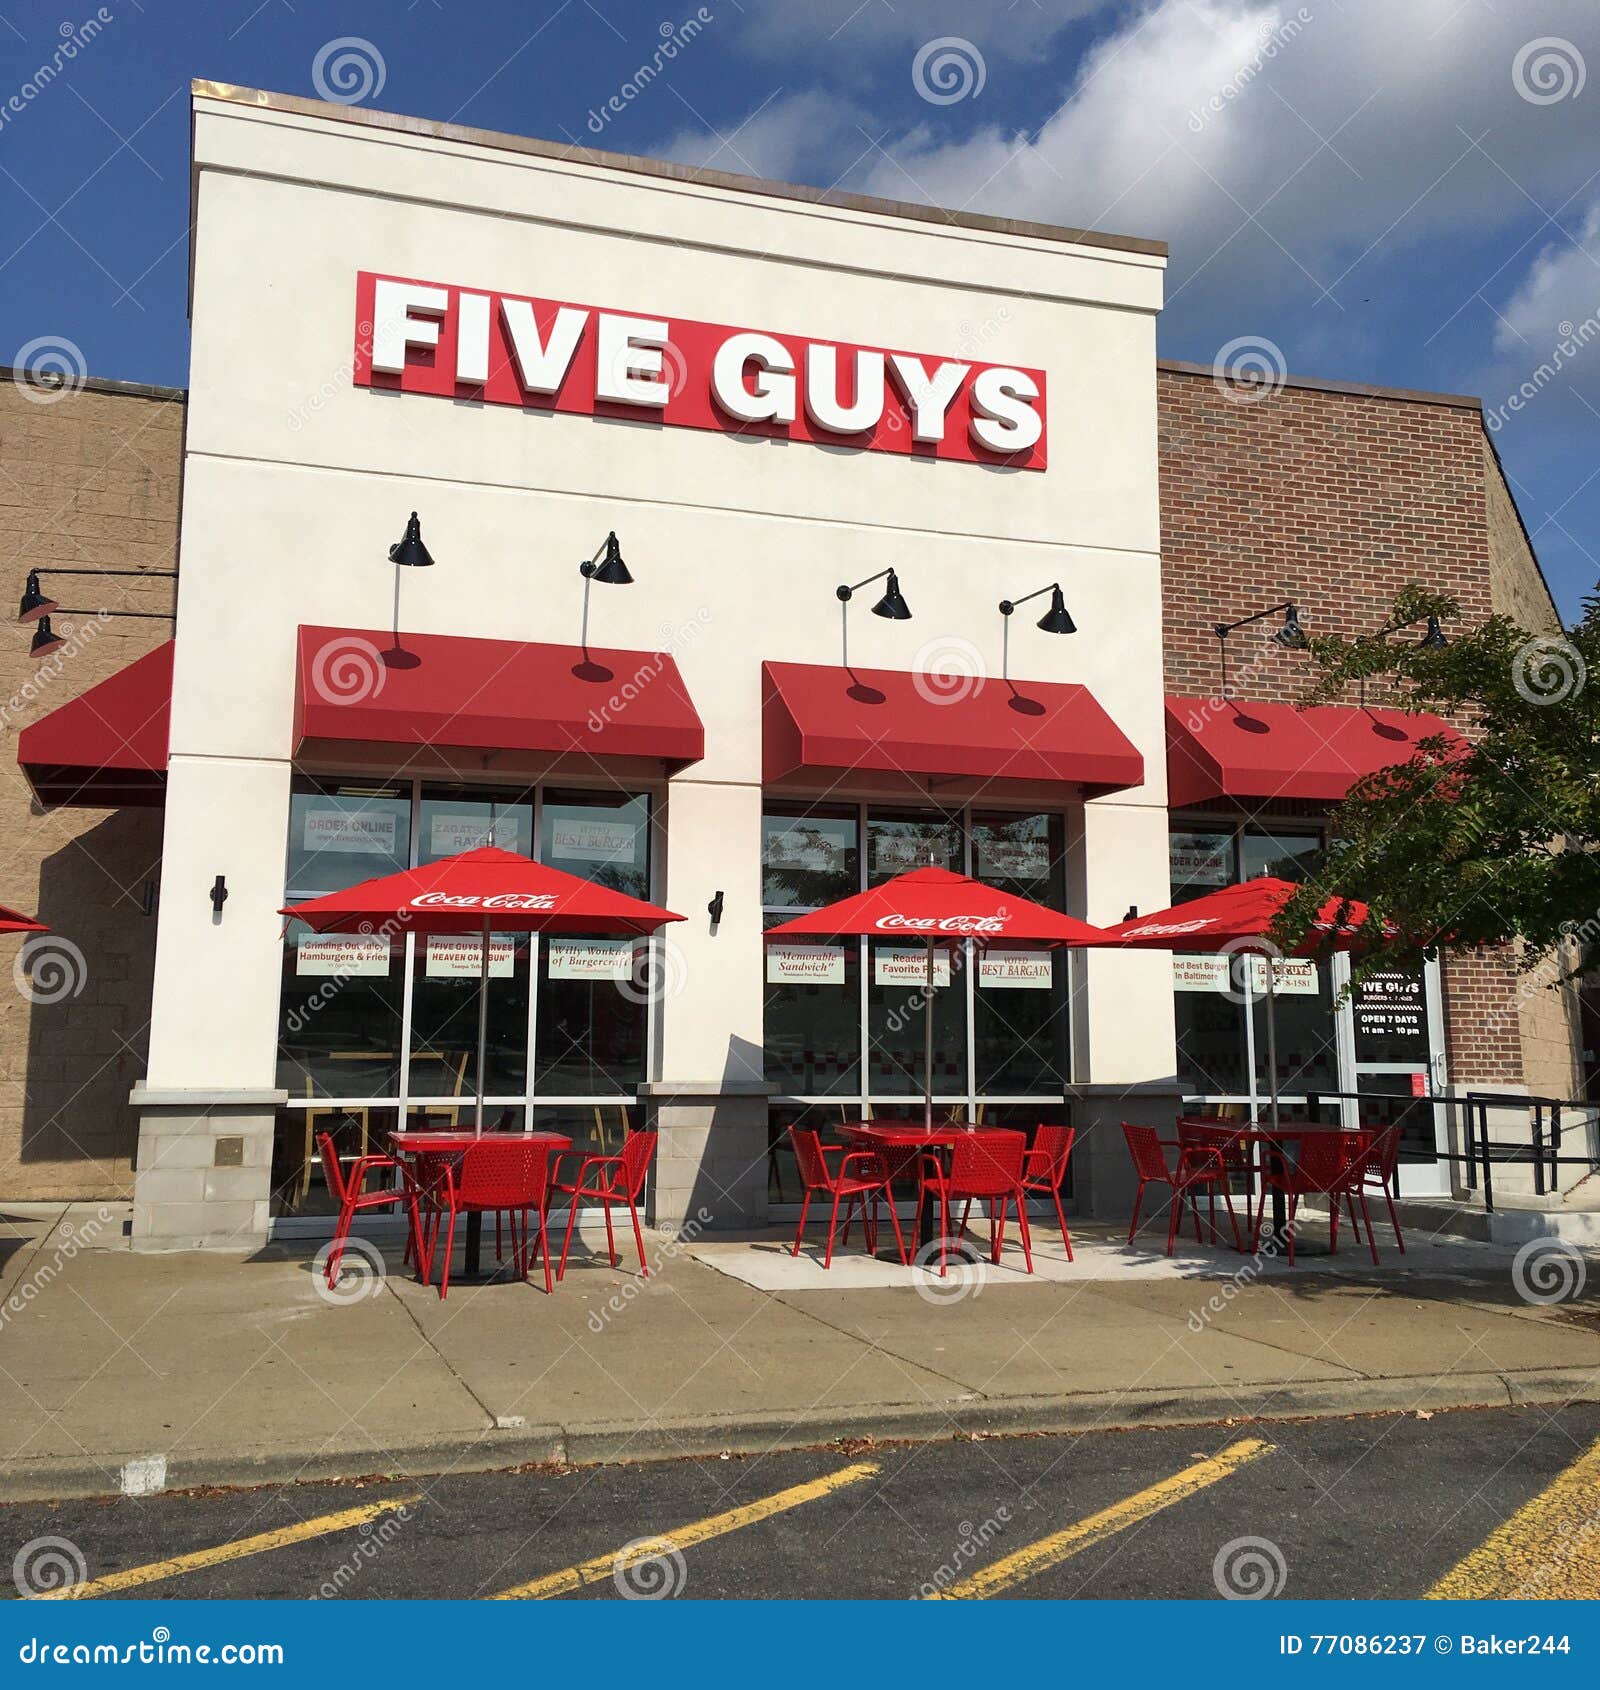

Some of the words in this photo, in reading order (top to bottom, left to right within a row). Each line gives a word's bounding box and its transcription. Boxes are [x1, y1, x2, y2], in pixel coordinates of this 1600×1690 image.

[371, 278, 669, 408] FIVE
[711, 332, 1043, 453] GUYS
[453, 835, 494, 848] RATE
[410, 891, 560, 909] Coca-Cola
[875, 913, 1006, 932] Coca-Cola
[304, 941, 343, 951] Grinding
[455, 943, 479, 951] GUYS
[479, 943, 513, 951] SRVES
[300, 951, 355, 962] Hamburgers
[356, 952, 365, 961] &
[366, 953, 388, 961] Fries
[432, 953, 466, 961] HEAVEN
[467, 953, 479, 961] ON
[552, 956, 563, 968] of
[1186, 962, 1203, 970] Best
[1204, 963, 1228, 971] Burger
[882, 964, 921, 974] Favorite
[922, 965, 943, 974] Pck
[981, 964, 1004, 976] BEST
[1007, 965, 1050, 977] BARGAIN
[1183, 971, 1218, 980] Baltimore
[1361, 1014, 1386, 1023] OPEN
[1387, 1015, 1393, 1023] 7
[1395, 1015, 1418, 1024] DAYS
[1361, 1026, 1370, 1034] 11
[1396, 1026, 1406, 1034] 10
